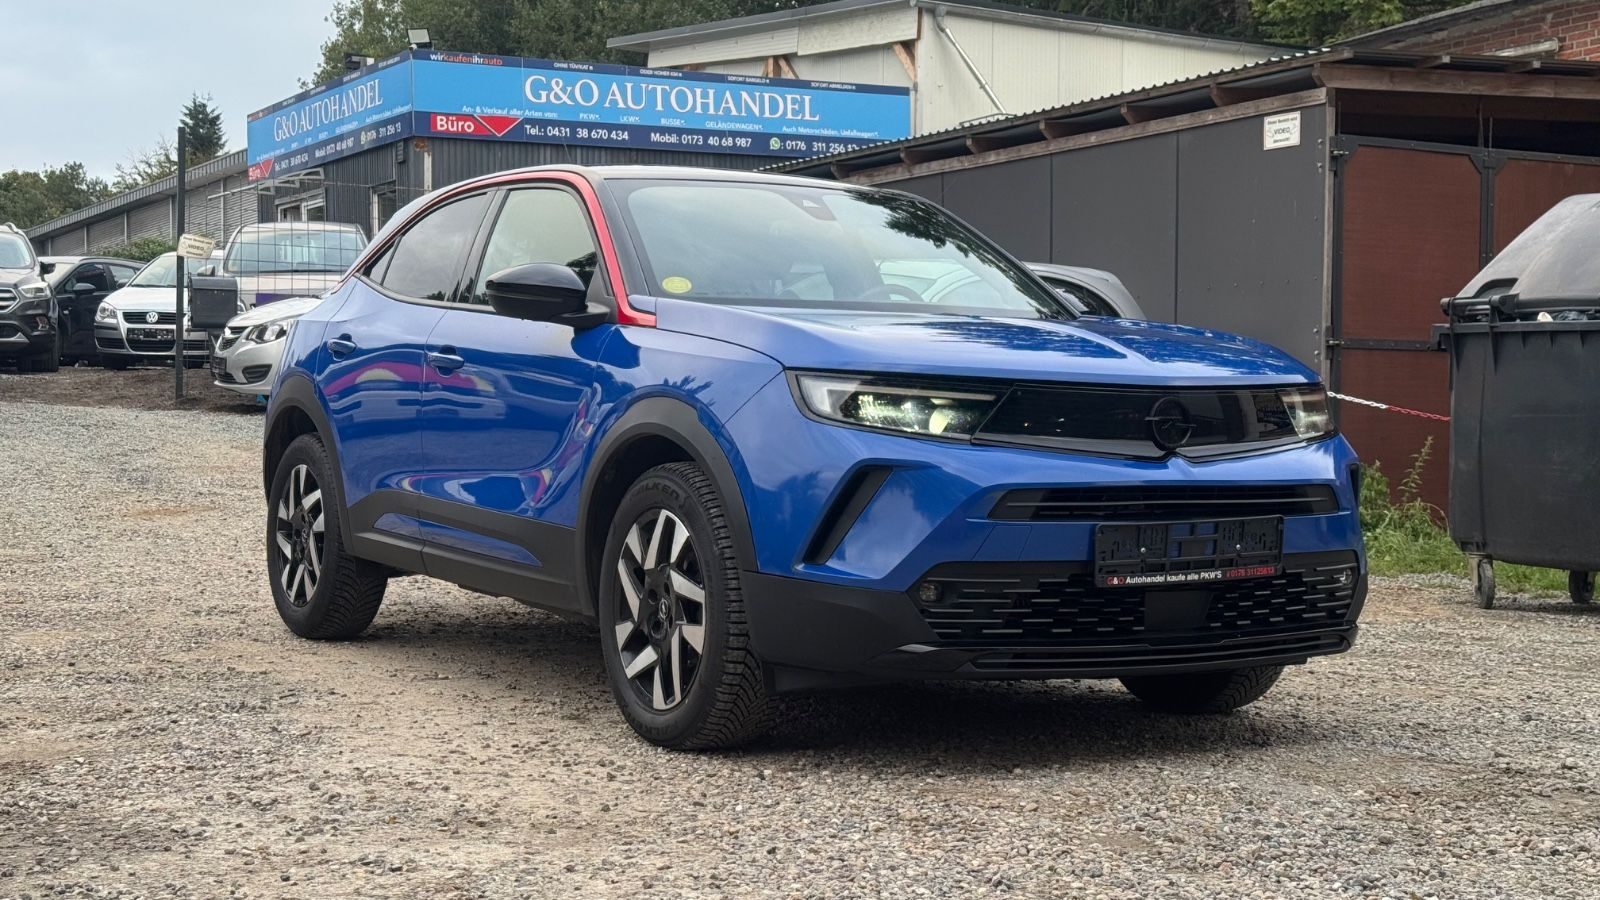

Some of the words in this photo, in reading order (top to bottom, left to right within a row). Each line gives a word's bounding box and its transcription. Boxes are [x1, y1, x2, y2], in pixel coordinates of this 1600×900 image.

[430, 52, 503, 66] wirkaufenihrauto
[525, 75, 599, 107] G&O
[604, 81, 820, 121] AUTOHANDEL
[274, 111, 298, 142] G&O
[299, 79, 383, 133] AUTOHANDEL
[482, 106, 508, 115] Verkauf
[510, 108, 524, 116] aller
[525, 109, 543, 118] Arten
[436, 115, 475, 133] Büro
[782, 125, 797, 133] Auch
[1273, 126, 1291, 135] VIDEO
[525, 124, 545, 136] Tel.:
[547, 126, 570, 138] 0431
[576, 127, 589, 139] 38
[591, 128, 608, 140] 670
[610, 130, 629, 141] 434
[650, 132, 680, 144] Mobil:
[681, 134, 703, 145] 0173
[707, 135, 720, 147] 40
[721, 136, 733, 147] 68
[735, 137, 752, 149] 987
[785, 139, 807, 151] 0176
[812, 141, 827, 152] 311
[829, 142, 846, 153] 256
[187, 243, 205, 252] VIDEO
[1106, 575, 1125, 585] G&O
[1125, 571, 1166, 584] Autohandel
[1166, 570, 1186, 582] kaufe
[1186, 572, 1199, 581] alle
[1200, 570, 1222, 580] PKW'S
